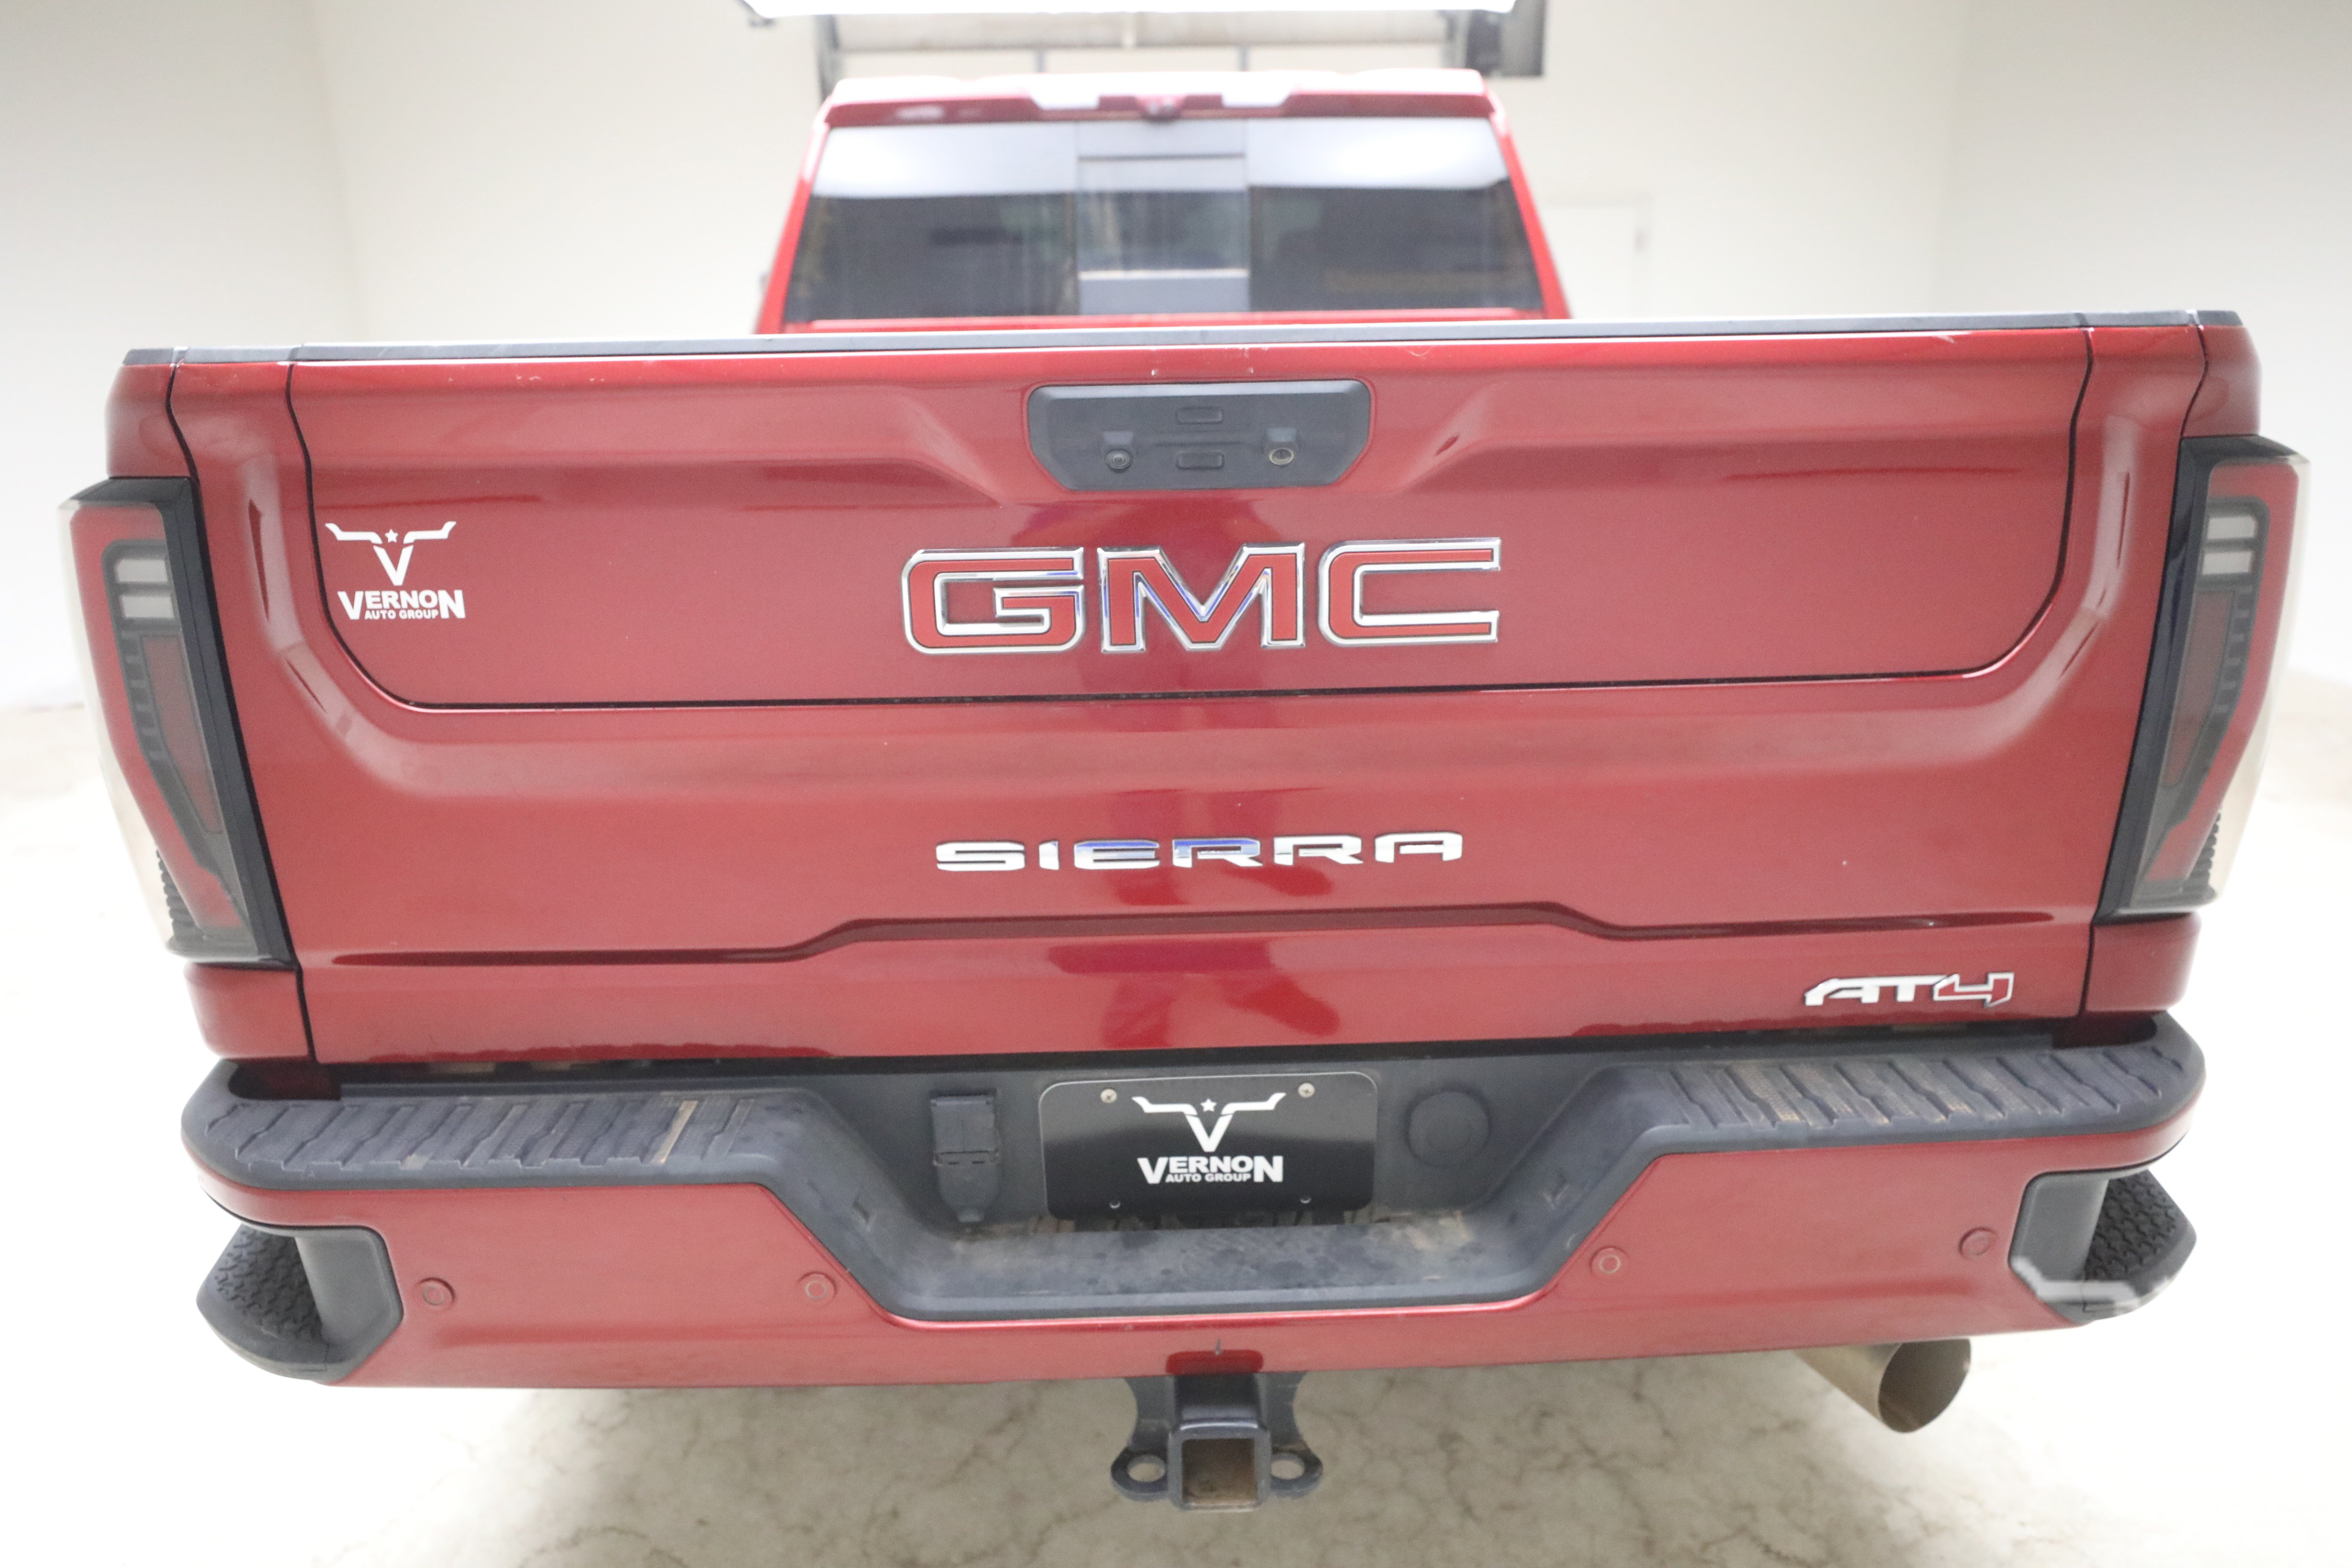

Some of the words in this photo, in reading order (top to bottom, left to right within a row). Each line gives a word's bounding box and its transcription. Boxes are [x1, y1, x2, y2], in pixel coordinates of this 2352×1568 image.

[337, 589, 466, 620] VERNON
[902, 537, 1501, 654] GMC
[365, 609, 396, 620] AUTO
[399, 609, 439, 619] GROUP
[936, 831, 1463, 872] SIERRA
[1804, 973, 2015, 1008] AT4
[1137, 1155, 1283, 1184] VERNON
[1165, 1174, 1202, 1183] AUTO
[1205, 1173, 1251, 1182] GROUP
